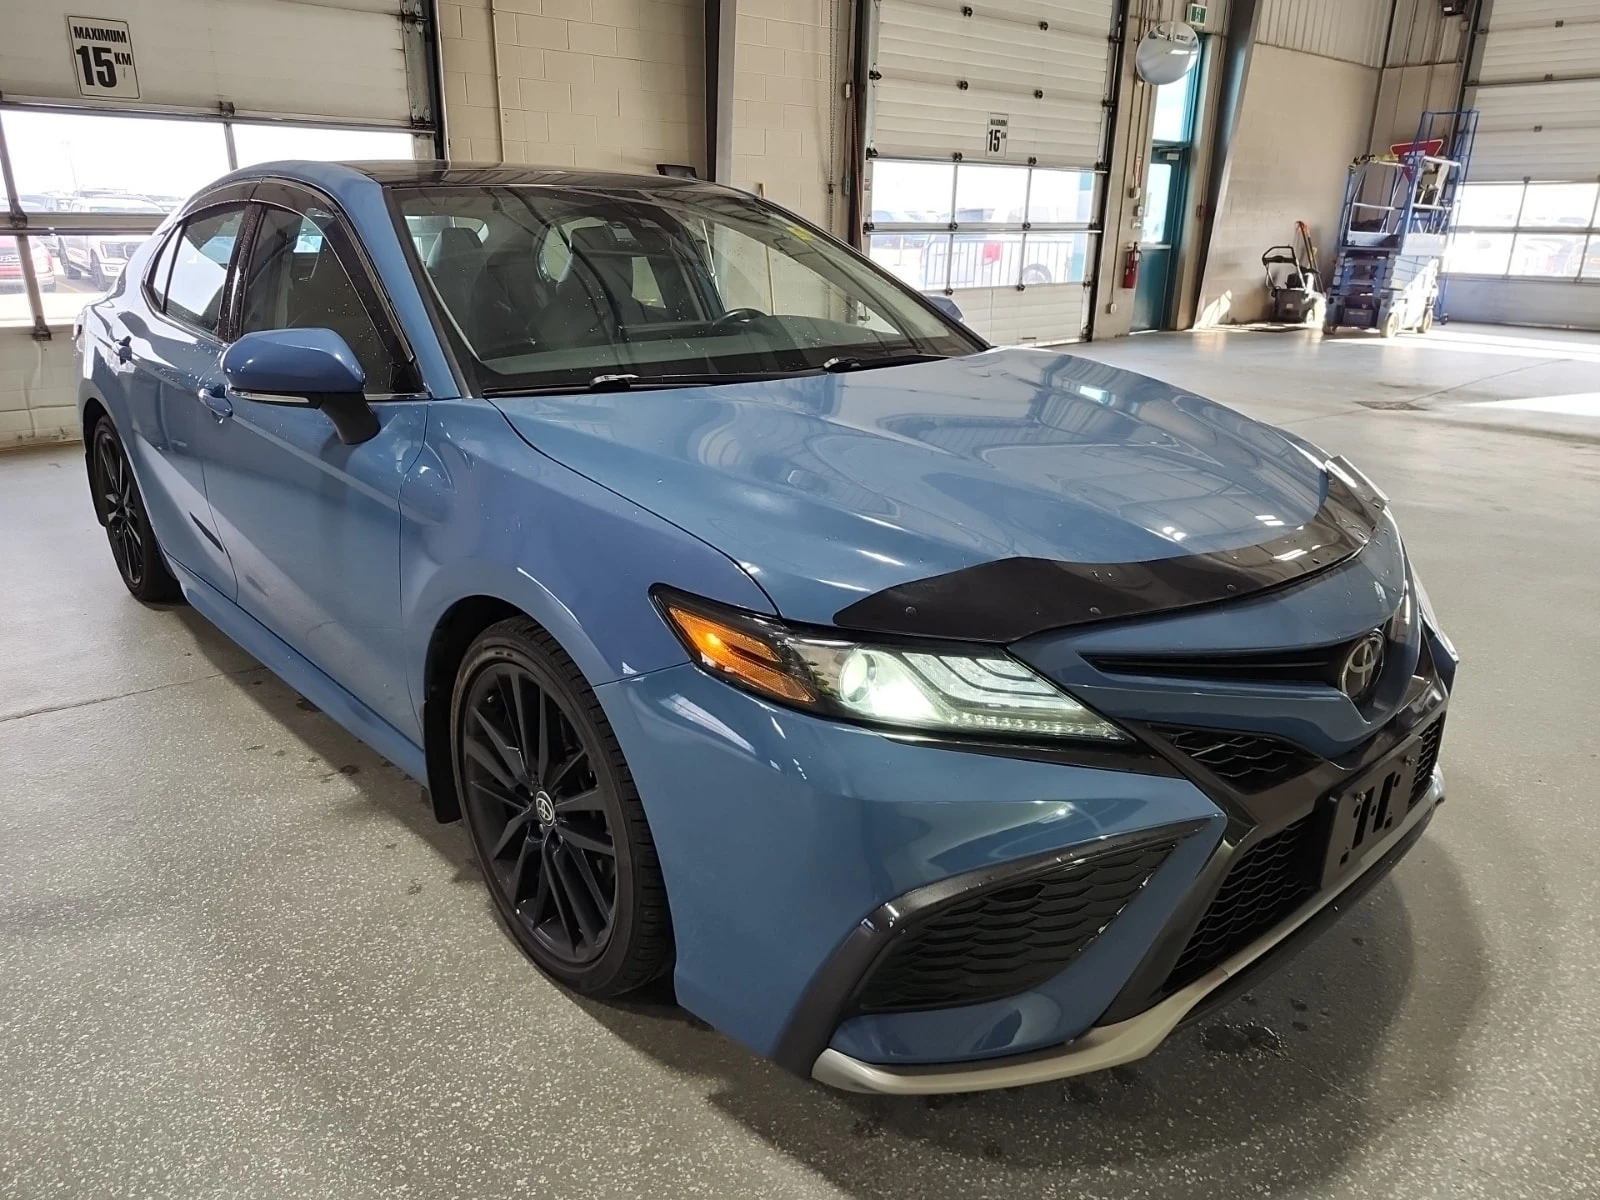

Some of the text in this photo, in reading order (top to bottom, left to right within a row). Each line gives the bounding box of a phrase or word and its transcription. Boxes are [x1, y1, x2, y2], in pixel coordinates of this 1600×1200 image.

[73, 26, 127, 43] MAXIMUM
[76, 45, 132, 88] 15 KM
[989, 129, 1001, 152] 15
